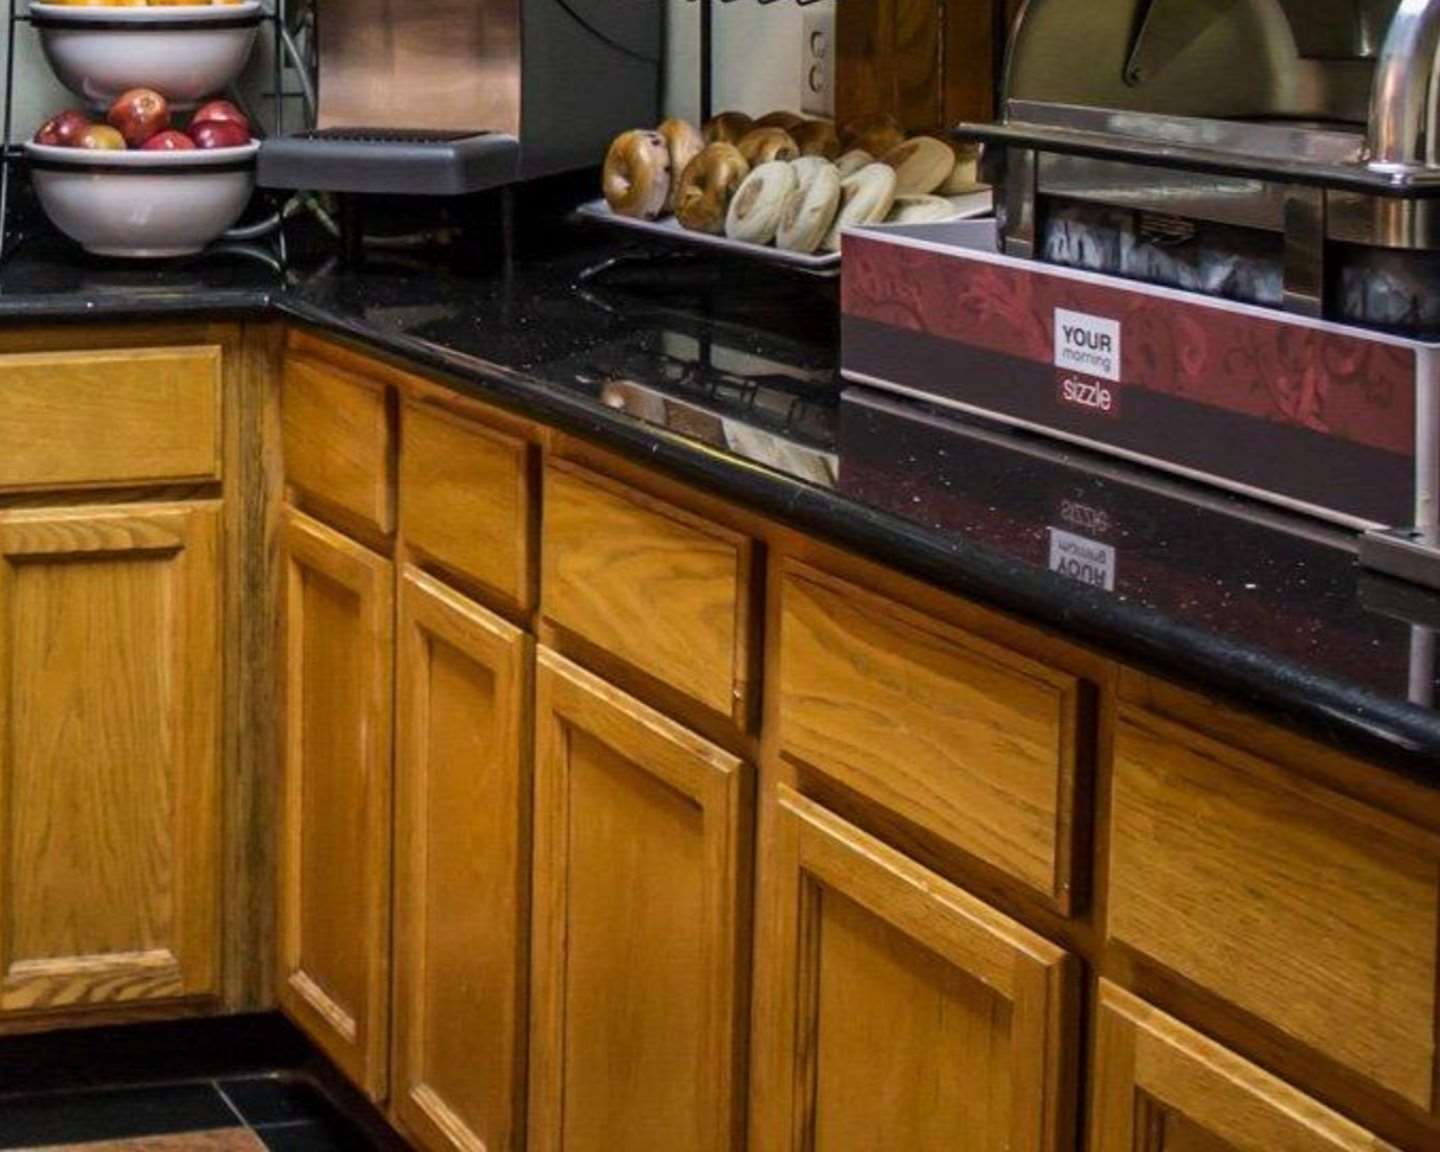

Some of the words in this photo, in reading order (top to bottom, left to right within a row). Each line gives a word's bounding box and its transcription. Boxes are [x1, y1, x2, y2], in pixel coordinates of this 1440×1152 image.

[1062, 325, 1111, 353] YOUR
[1062, 348, 1111, 373] morning
[1063, 375, 1111, 411] sizzle
